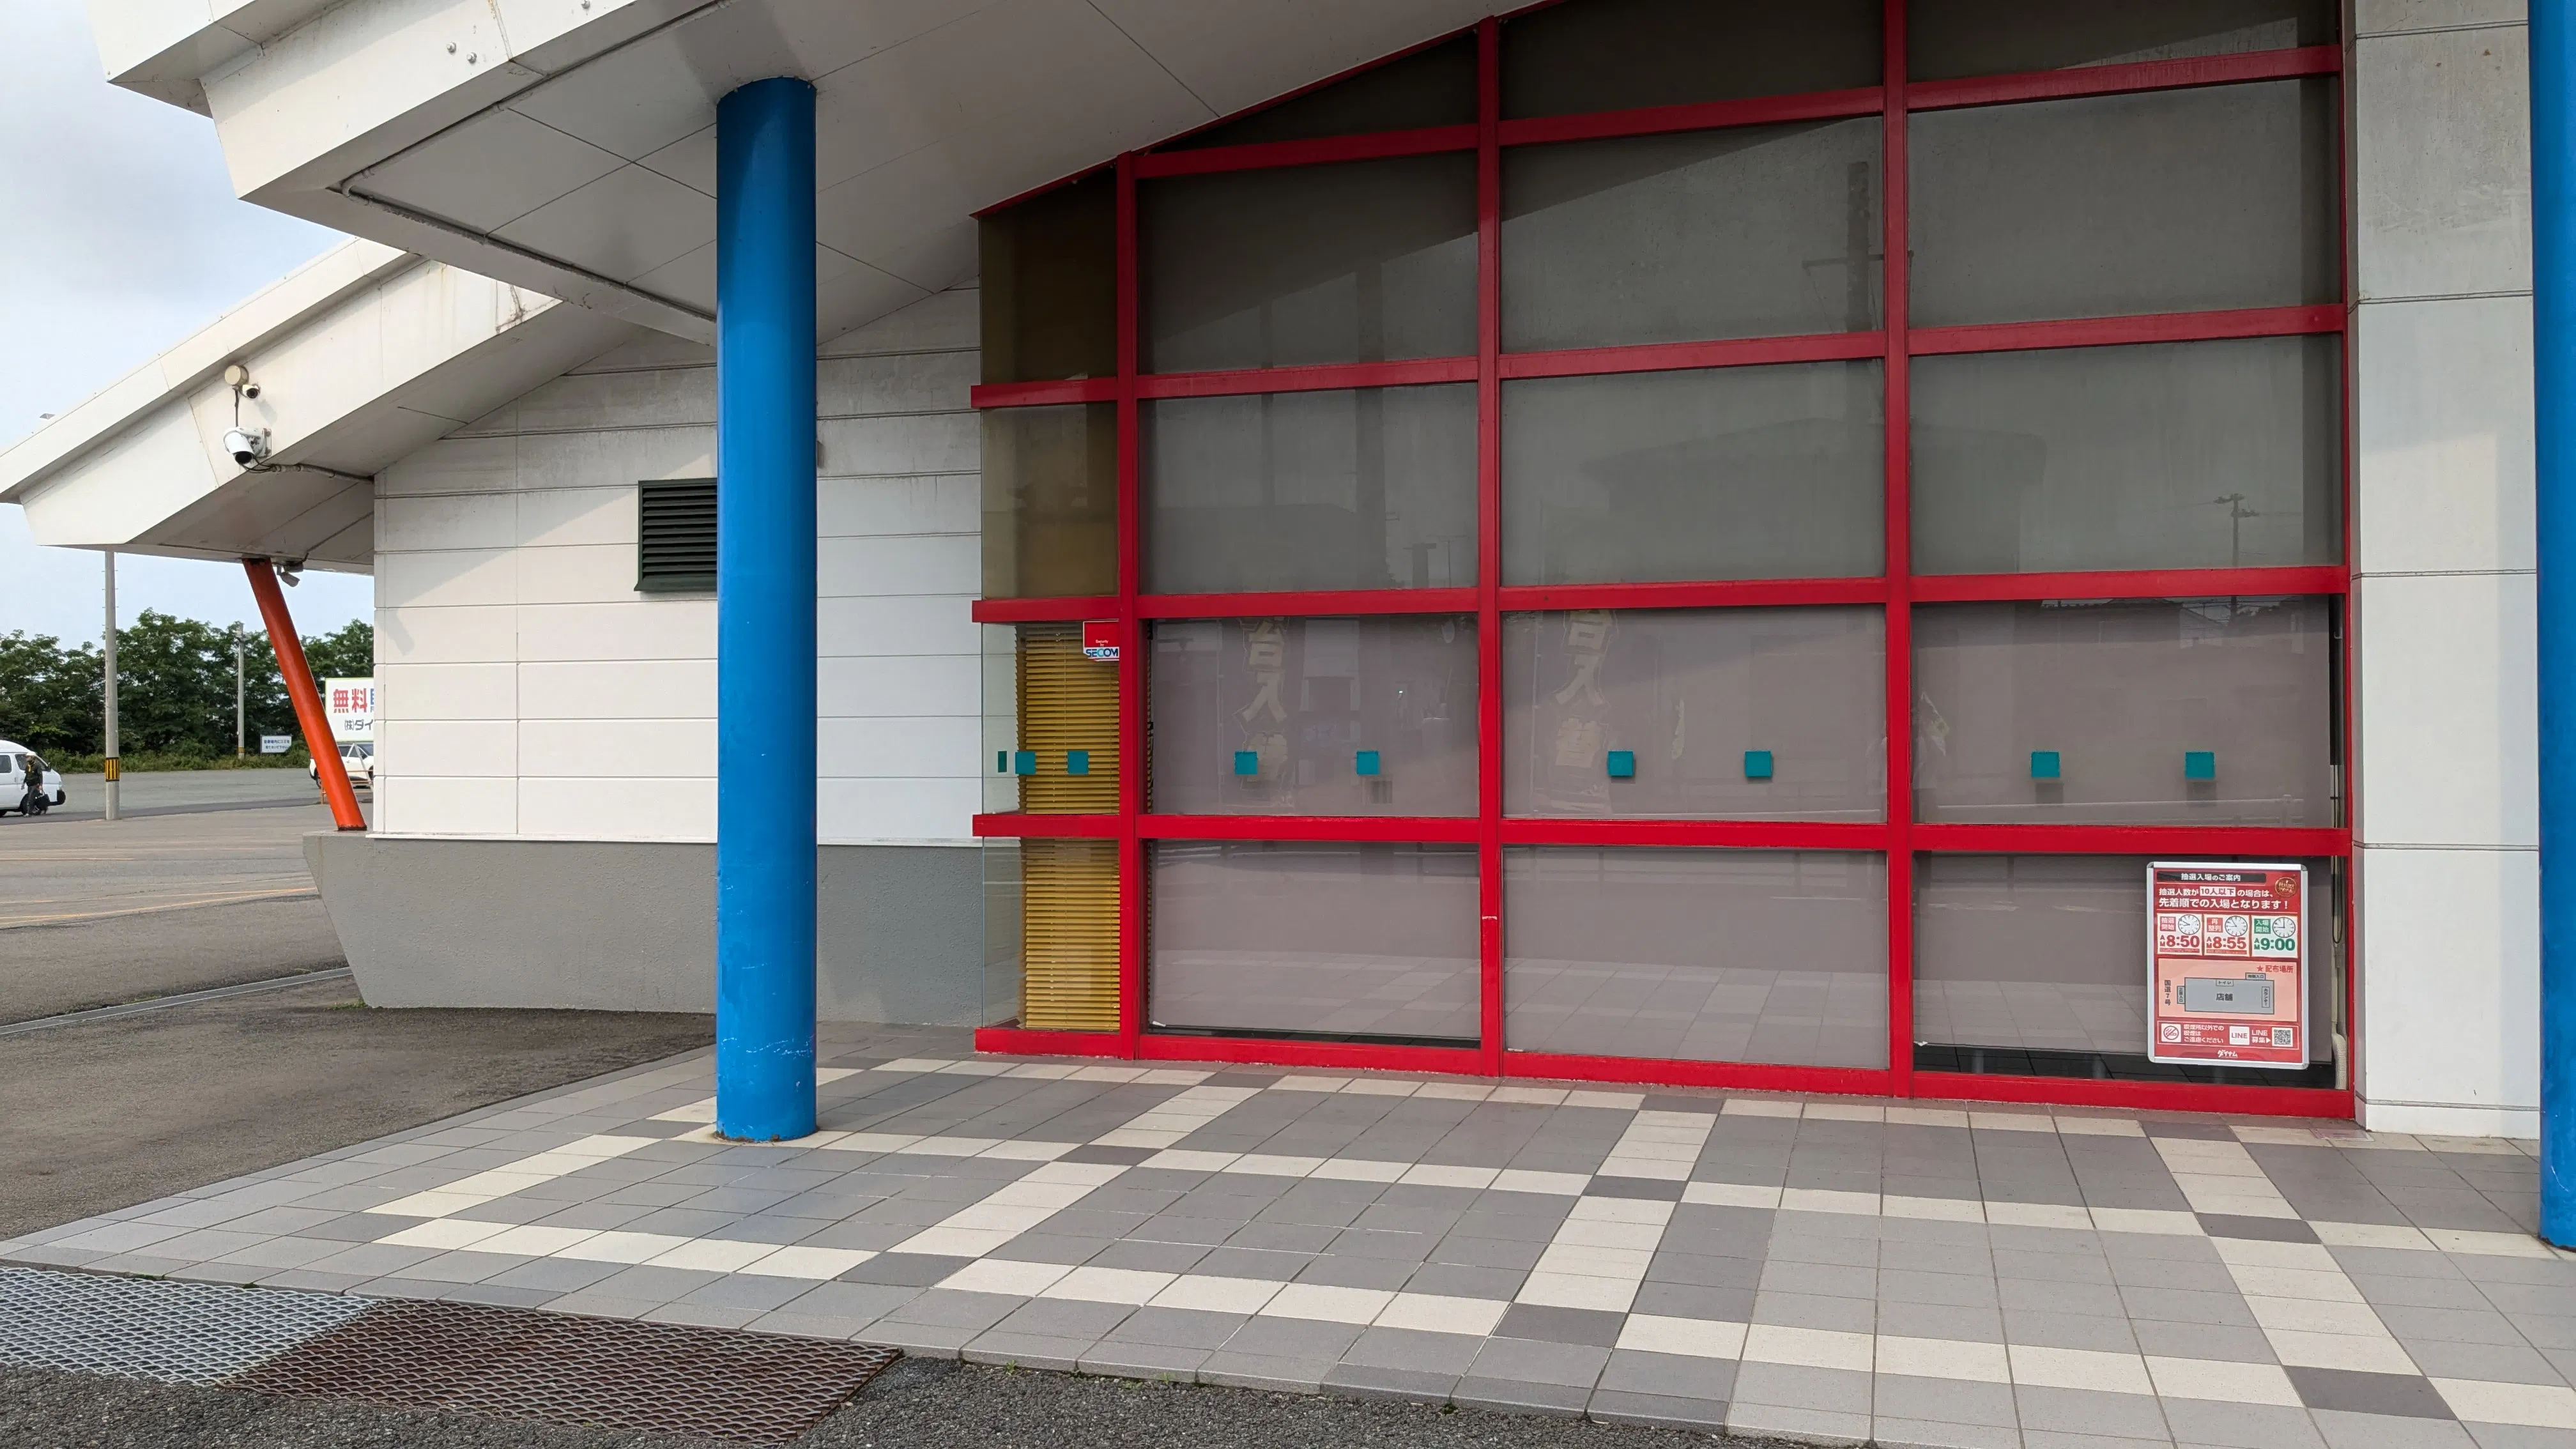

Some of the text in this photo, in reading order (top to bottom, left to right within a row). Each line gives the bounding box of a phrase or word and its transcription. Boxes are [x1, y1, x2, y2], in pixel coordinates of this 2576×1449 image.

[1086, 648, 1118, 657] SECOM
[334, 687, 374, 713] 無料
[2181, 873, 2241, 882] 抽選入場のご案内
[2159, 898, 2288, 909] 先着順での入場となります！
[2166, 935, 2200, 947] 8:50
[2212, 937, 2246, 949] 8:55
[2260, 938, 2295, 951] 9:00
[2266, 965, 2294, 973] 配布場所
[2216, 993, 2233, 1001] 店舗
